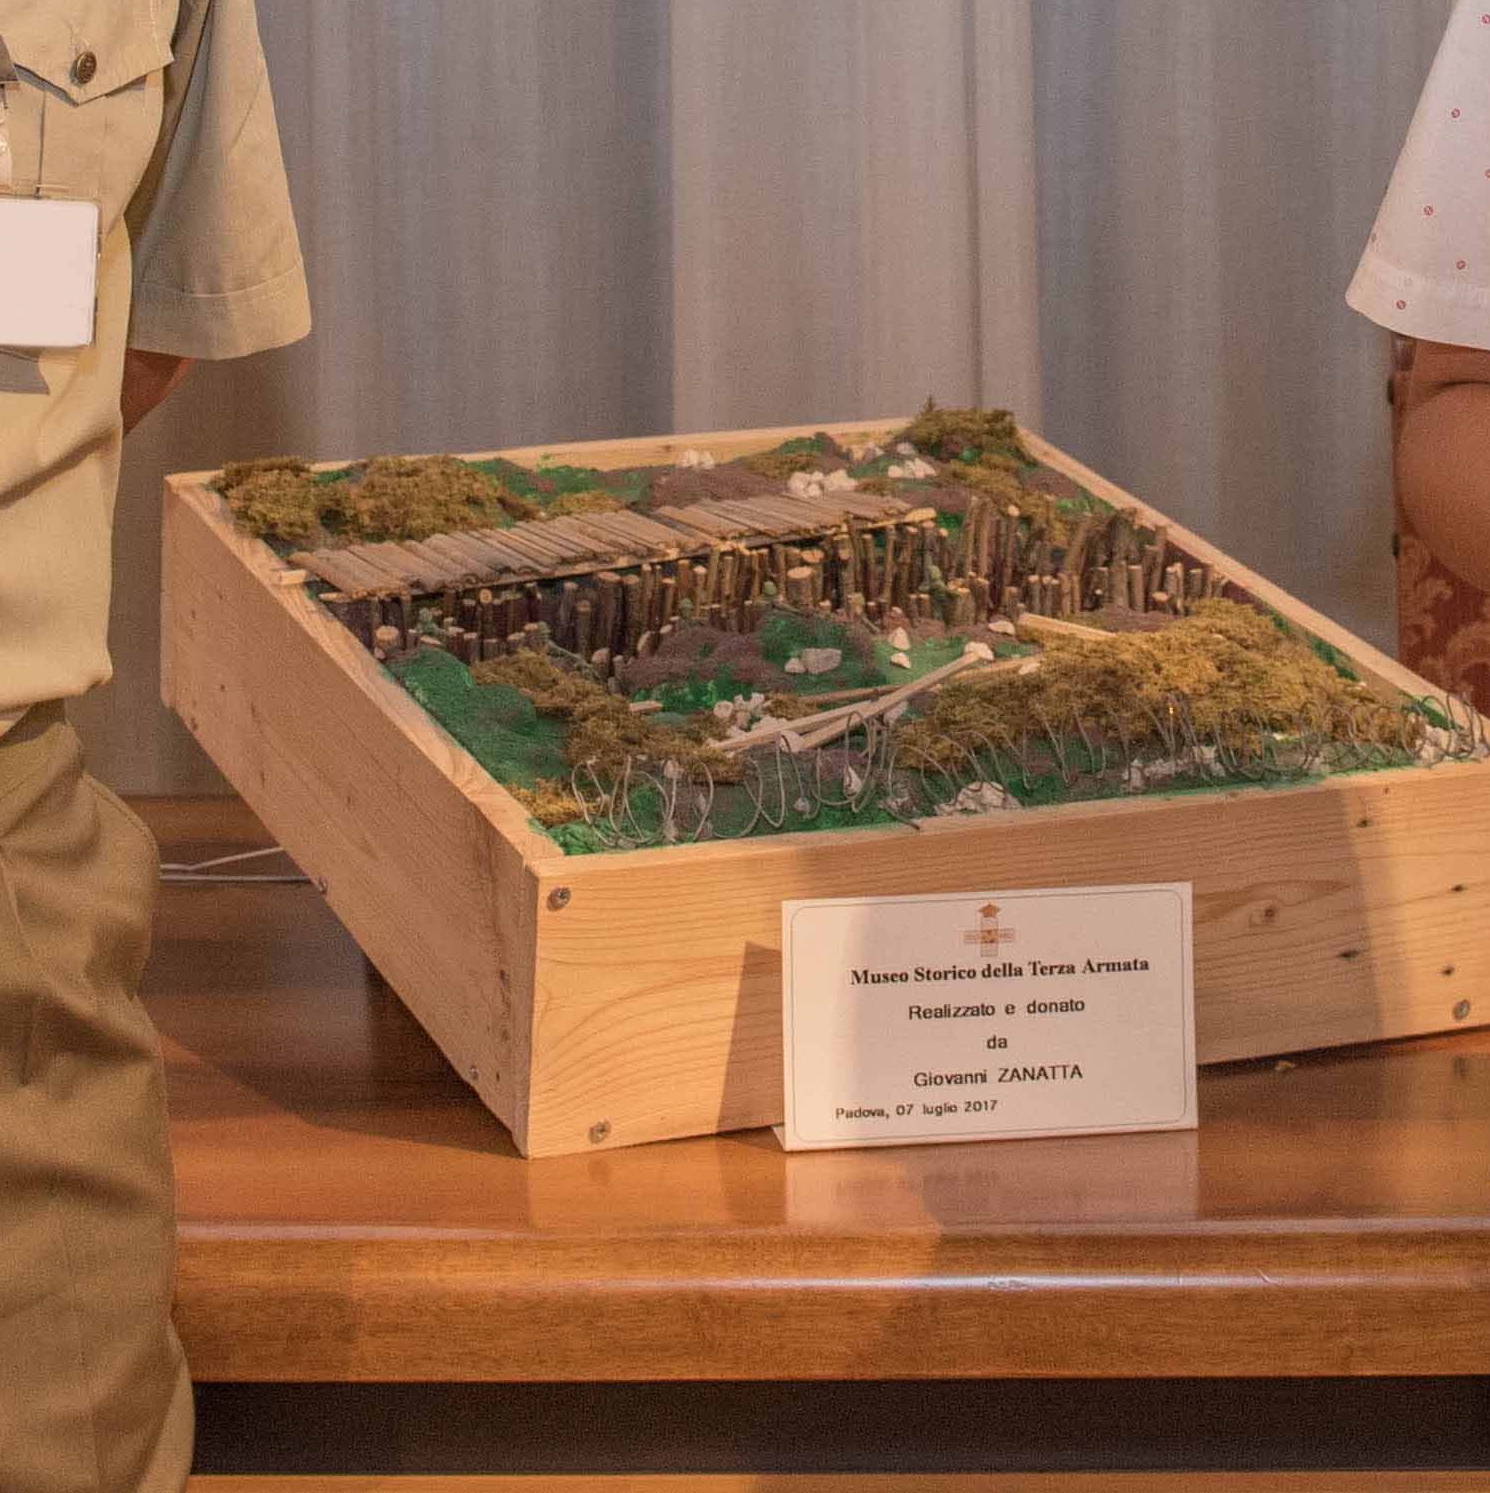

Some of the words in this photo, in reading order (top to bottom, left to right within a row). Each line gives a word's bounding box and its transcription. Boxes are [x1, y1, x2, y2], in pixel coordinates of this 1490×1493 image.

[850, 968, 909, 985] Museo
[913, 965, 977, 983] Storico
[981, 963, 1023, 979] della
[1028, 961, 1076, 976] Terza
[1081, 958, 1149, 974] Armata
[908, 1002, 995, 1020] Realizzato
[1004, 1004, 1016, 1015] e
[1026, 998, 1085, 1014] donato
[986, 1034, 1008, 1050] da
[913, 1069, 988, 1087] Giovanni
[998, 1064, 1083, 1083] ZANATTA
[835, 1104, 890, 1120] Padova,
[896, 1104, 913, 1116] 07
[922, 1101, 957, 1117] luglio
[964, 1100, 998, 1113] 2017
